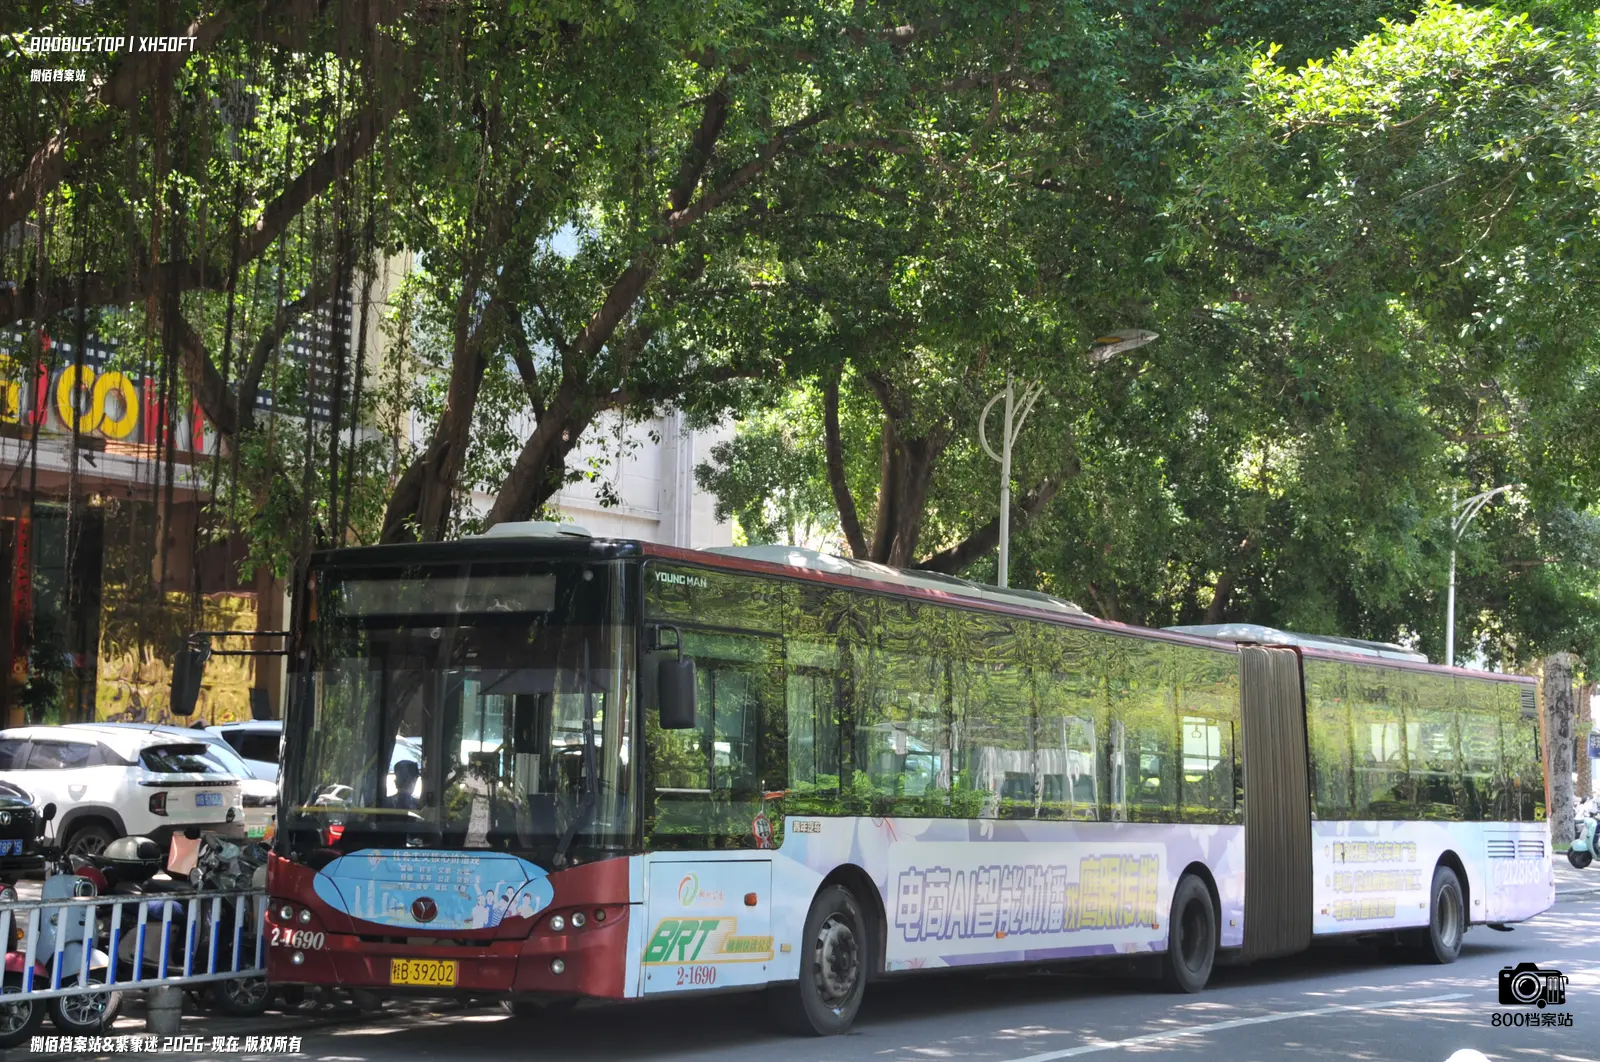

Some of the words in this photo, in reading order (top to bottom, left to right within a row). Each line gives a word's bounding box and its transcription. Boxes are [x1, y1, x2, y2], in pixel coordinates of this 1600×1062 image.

[896, 865, 1068, 942] 电商AI智能助播
[270, 927, 325, 951] 2-1690
[642, 920, 720, 962] BRT
